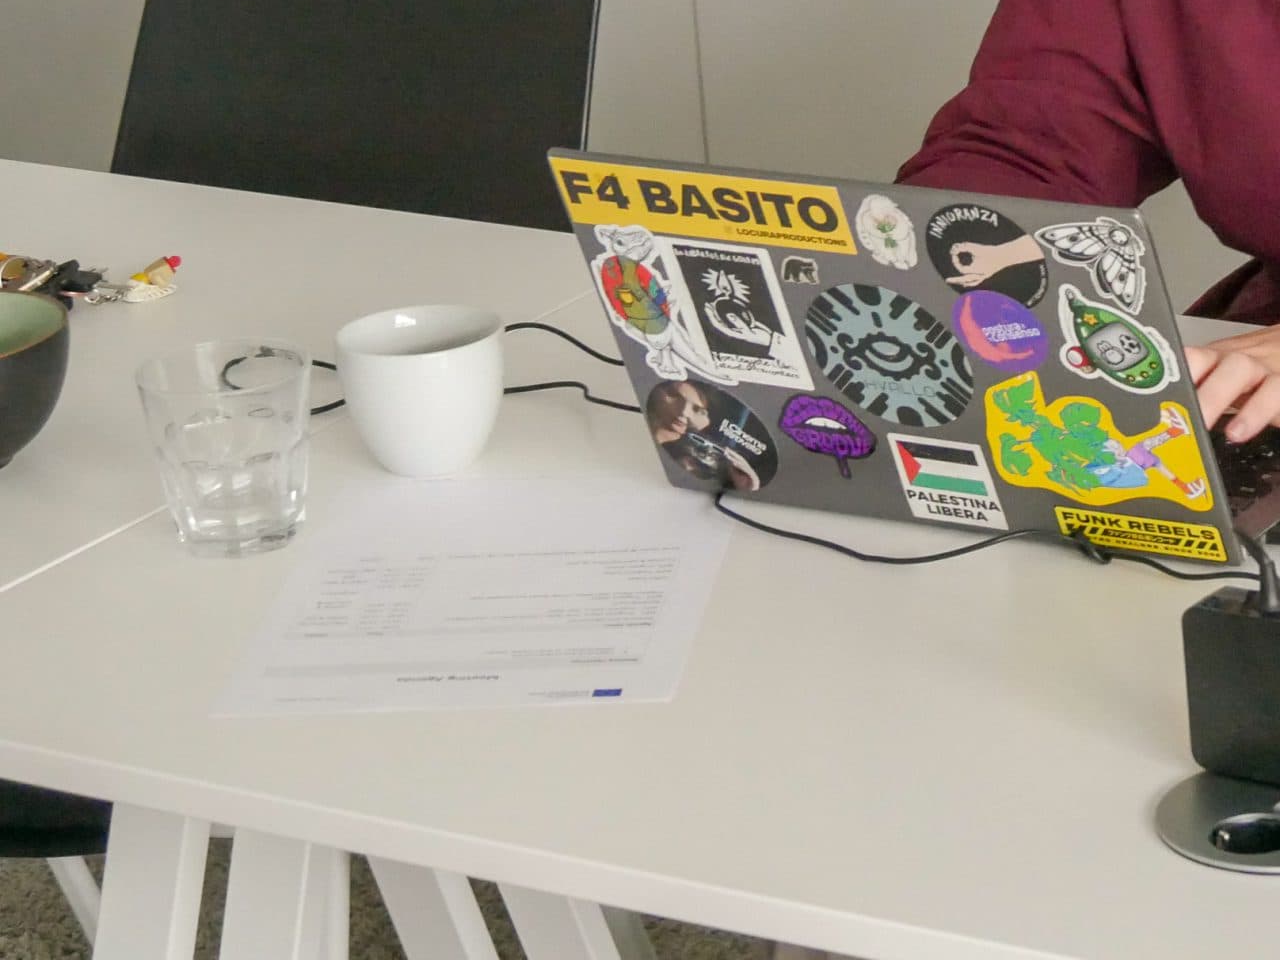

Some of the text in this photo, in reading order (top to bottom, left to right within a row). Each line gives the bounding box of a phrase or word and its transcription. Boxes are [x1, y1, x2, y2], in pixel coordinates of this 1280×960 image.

[560, 170, 840, 233] F4 BASITO
[907, 490, 1001, 512] PALESTINA
[927, 504, 988, 522] LIBERA
[1062, 512, 1123, 529] FUNK
[1128, 521, 1216, 540] REBELS
